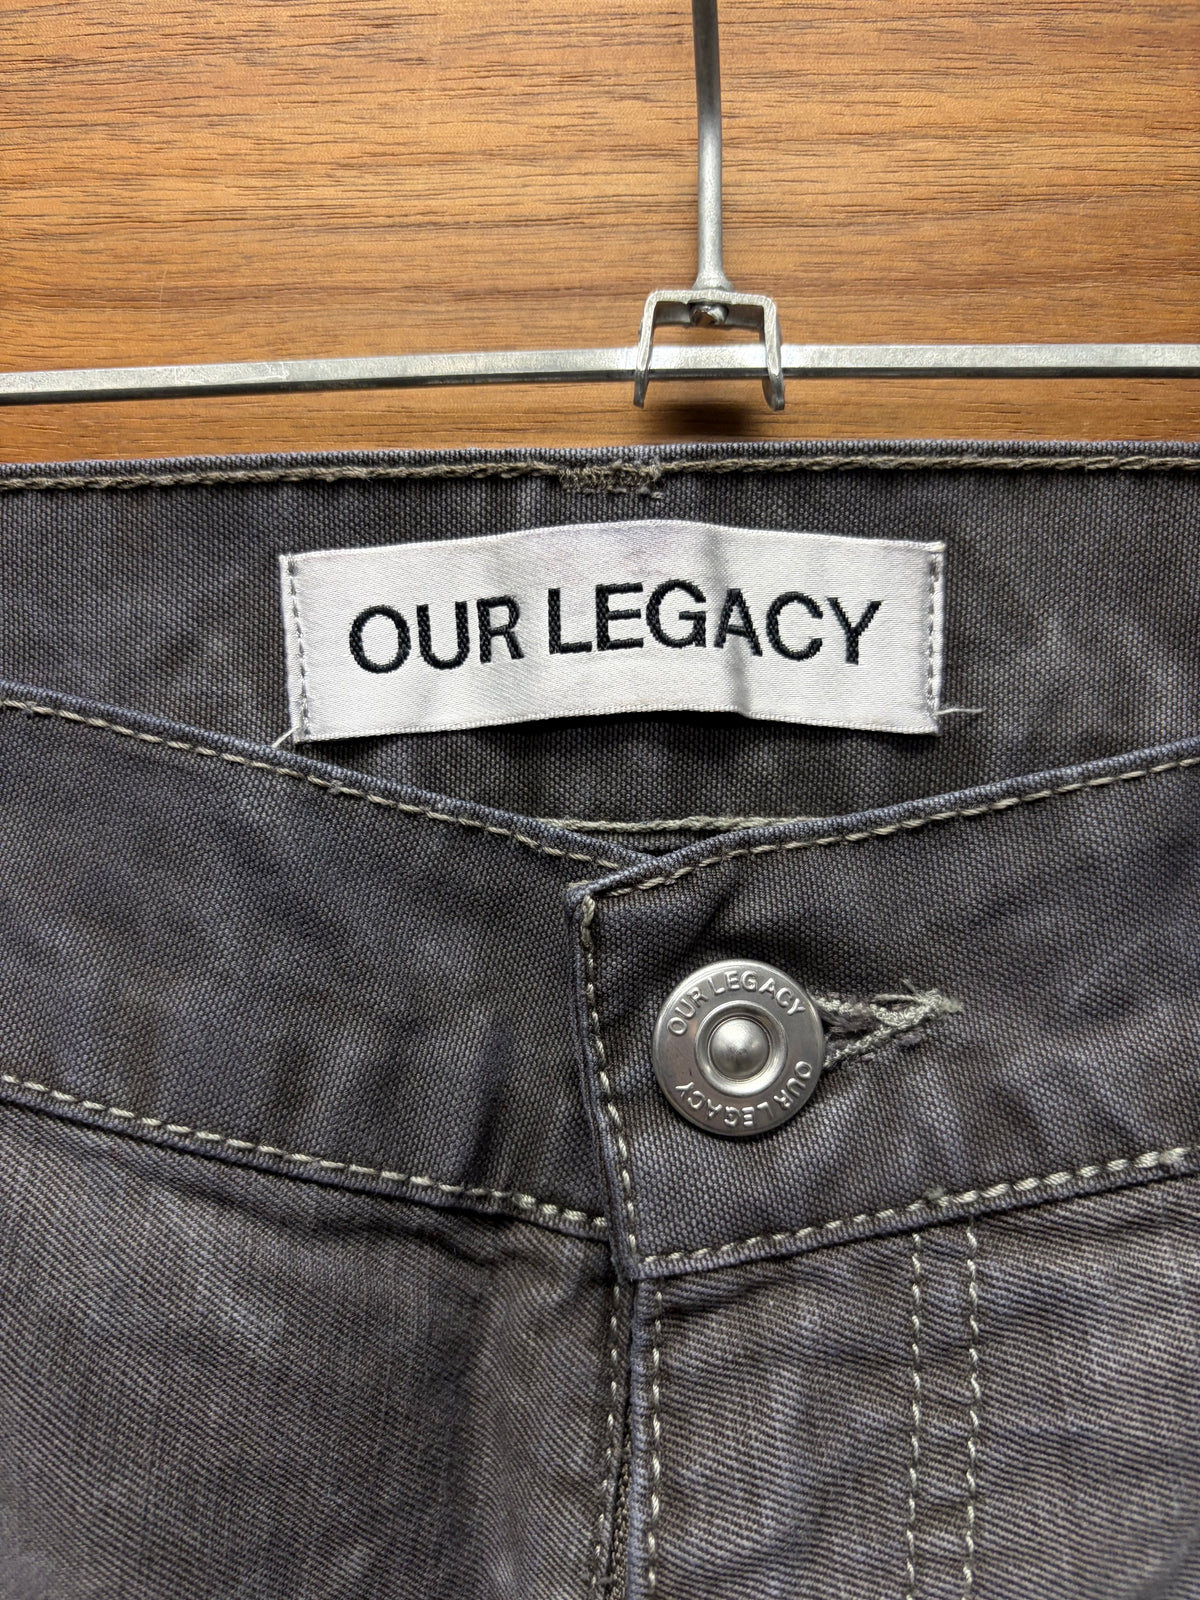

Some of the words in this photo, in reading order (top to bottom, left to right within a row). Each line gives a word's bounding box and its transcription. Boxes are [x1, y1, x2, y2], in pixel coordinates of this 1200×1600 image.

[348, 593, 526, 674] OUR
[547, 578, 882, 665] LEGACY
[667, 986, 709, 1036] OUR
[707, 970, 806, 1016] LEGACY
[675, 1081, 774, 1127] LEGACY
[773, 1060, 813, 1110] OUR
